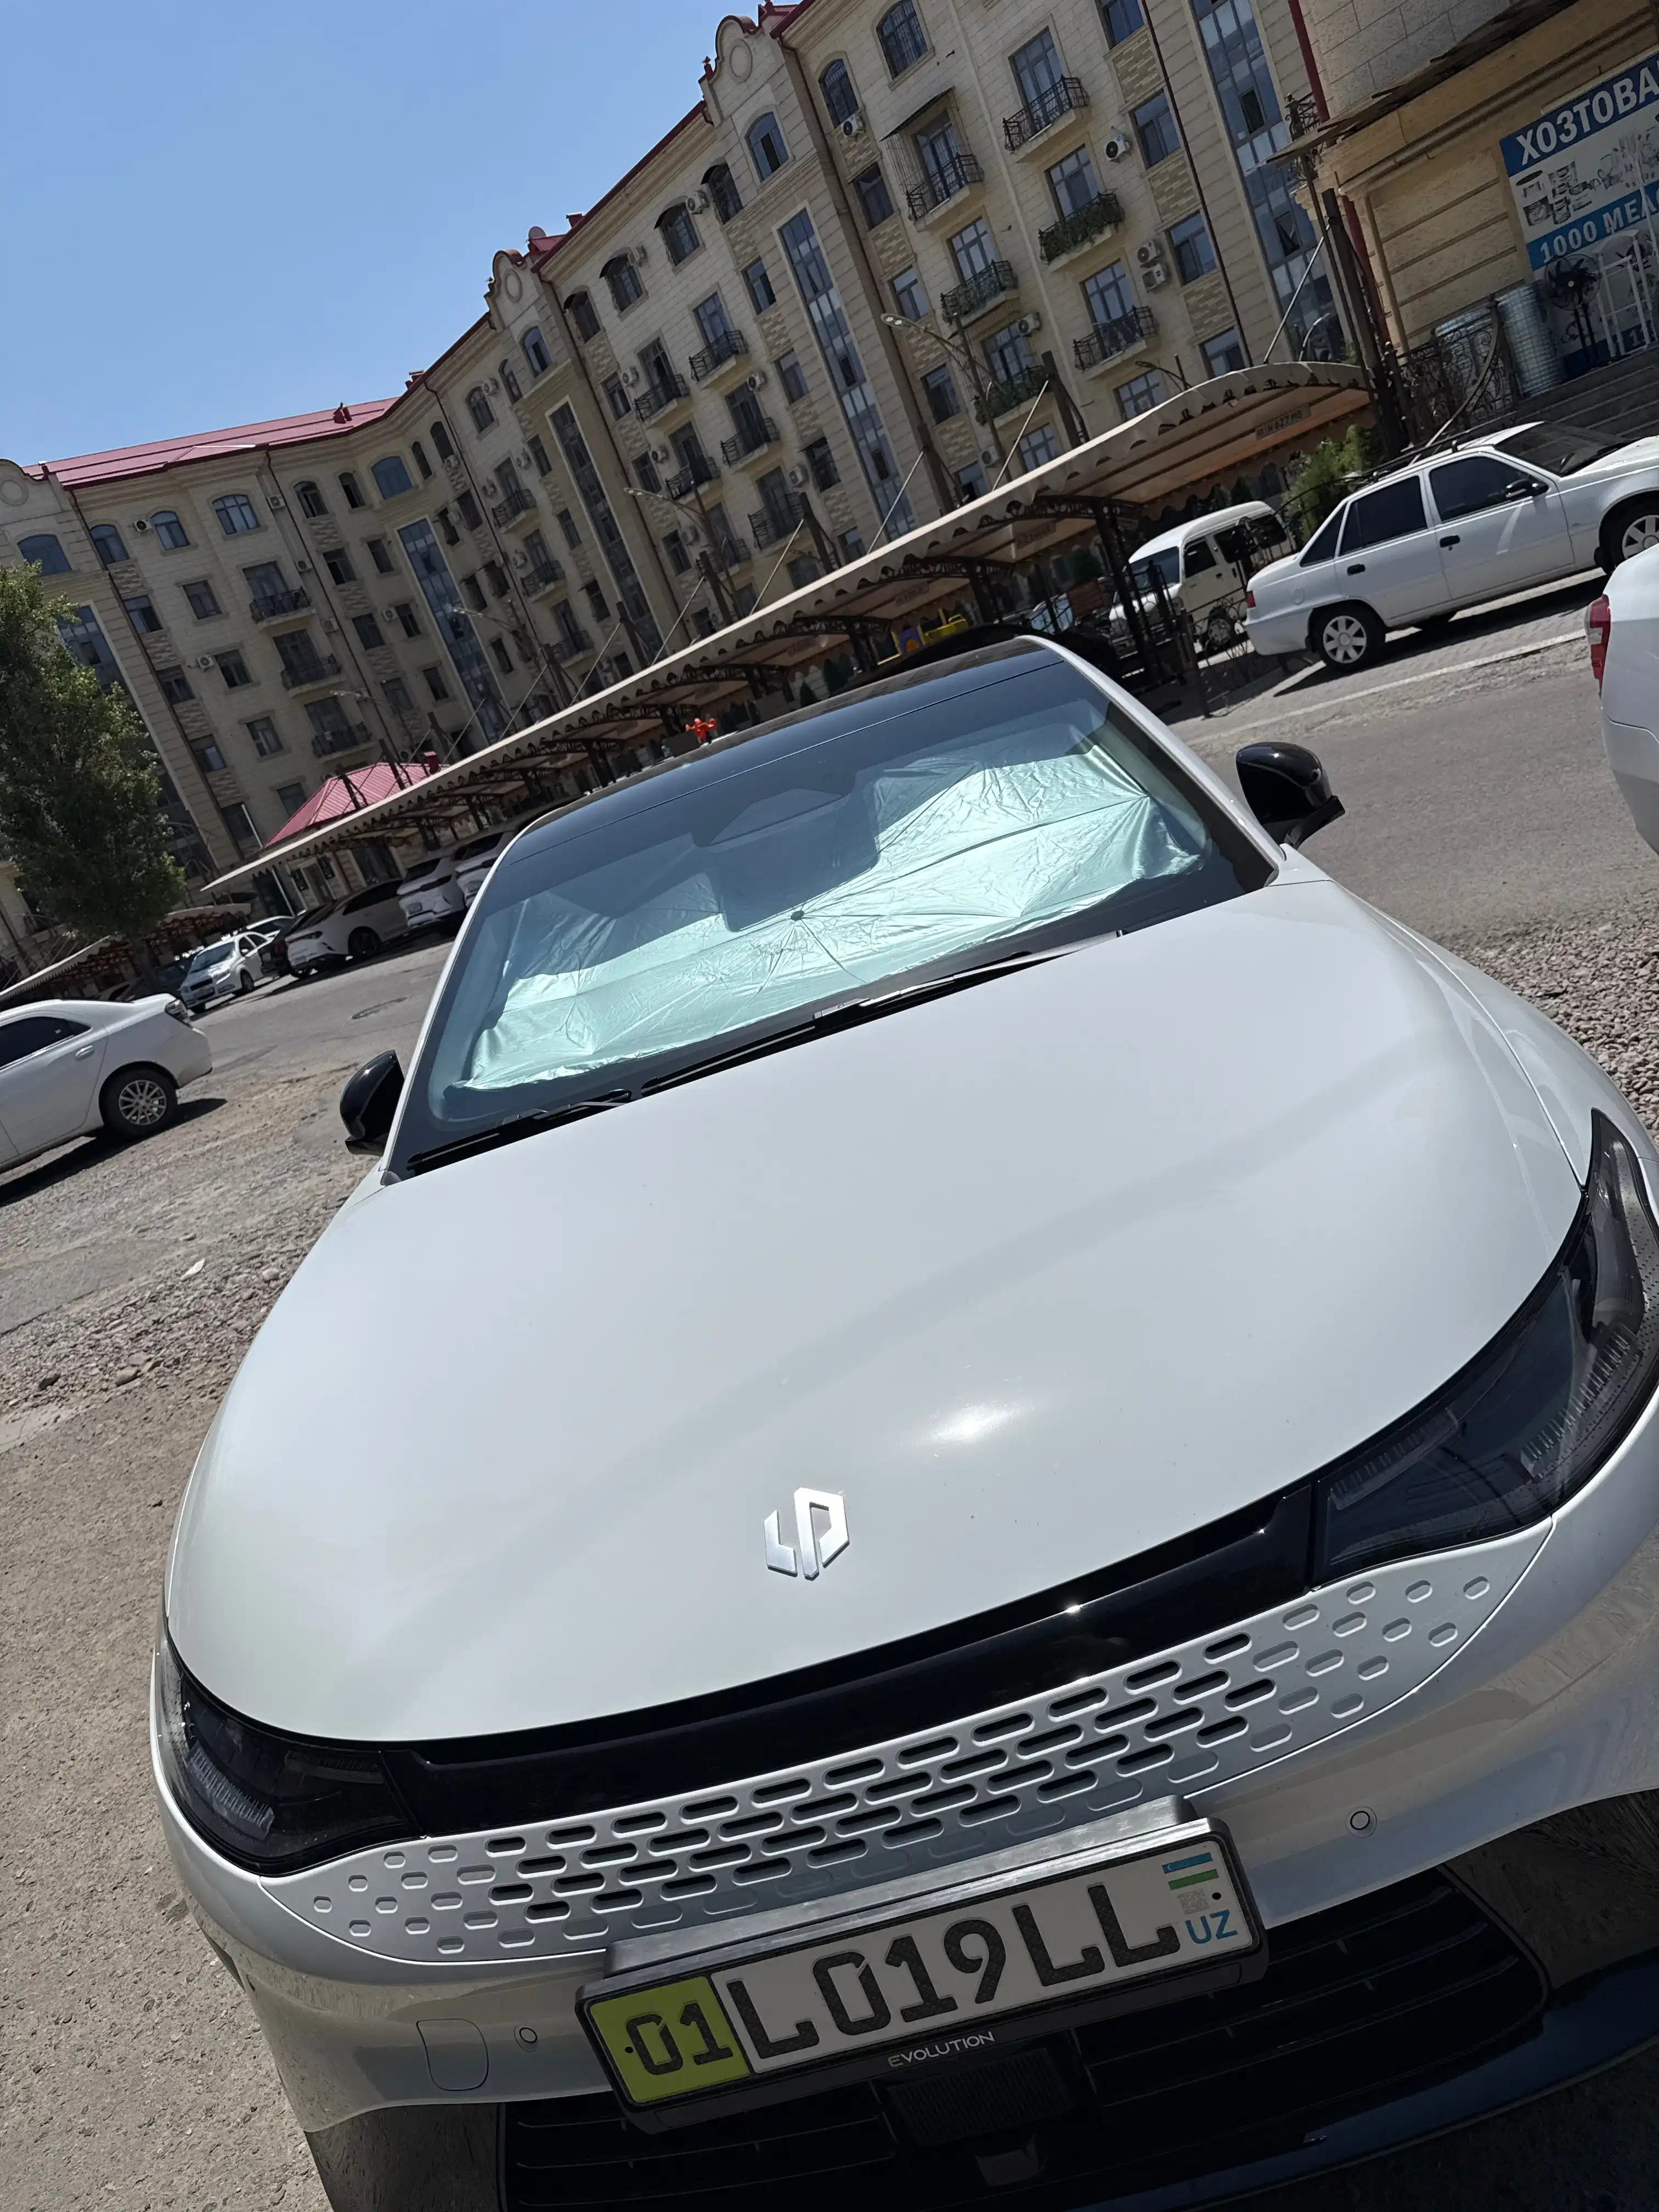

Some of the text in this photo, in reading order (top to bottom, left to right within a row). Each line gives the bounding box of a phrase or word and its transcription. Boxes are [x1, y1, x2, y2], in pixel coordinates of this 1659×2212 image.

[1516, 60, 1659, 166] ХОЗТОВА
[1541, 188, 1659, 263] 1000 МЕЛ
[626, 1884, 1238, 2075] 01 L019LL UZ
[888, 2031, 996, 2067] EVOLUTION
